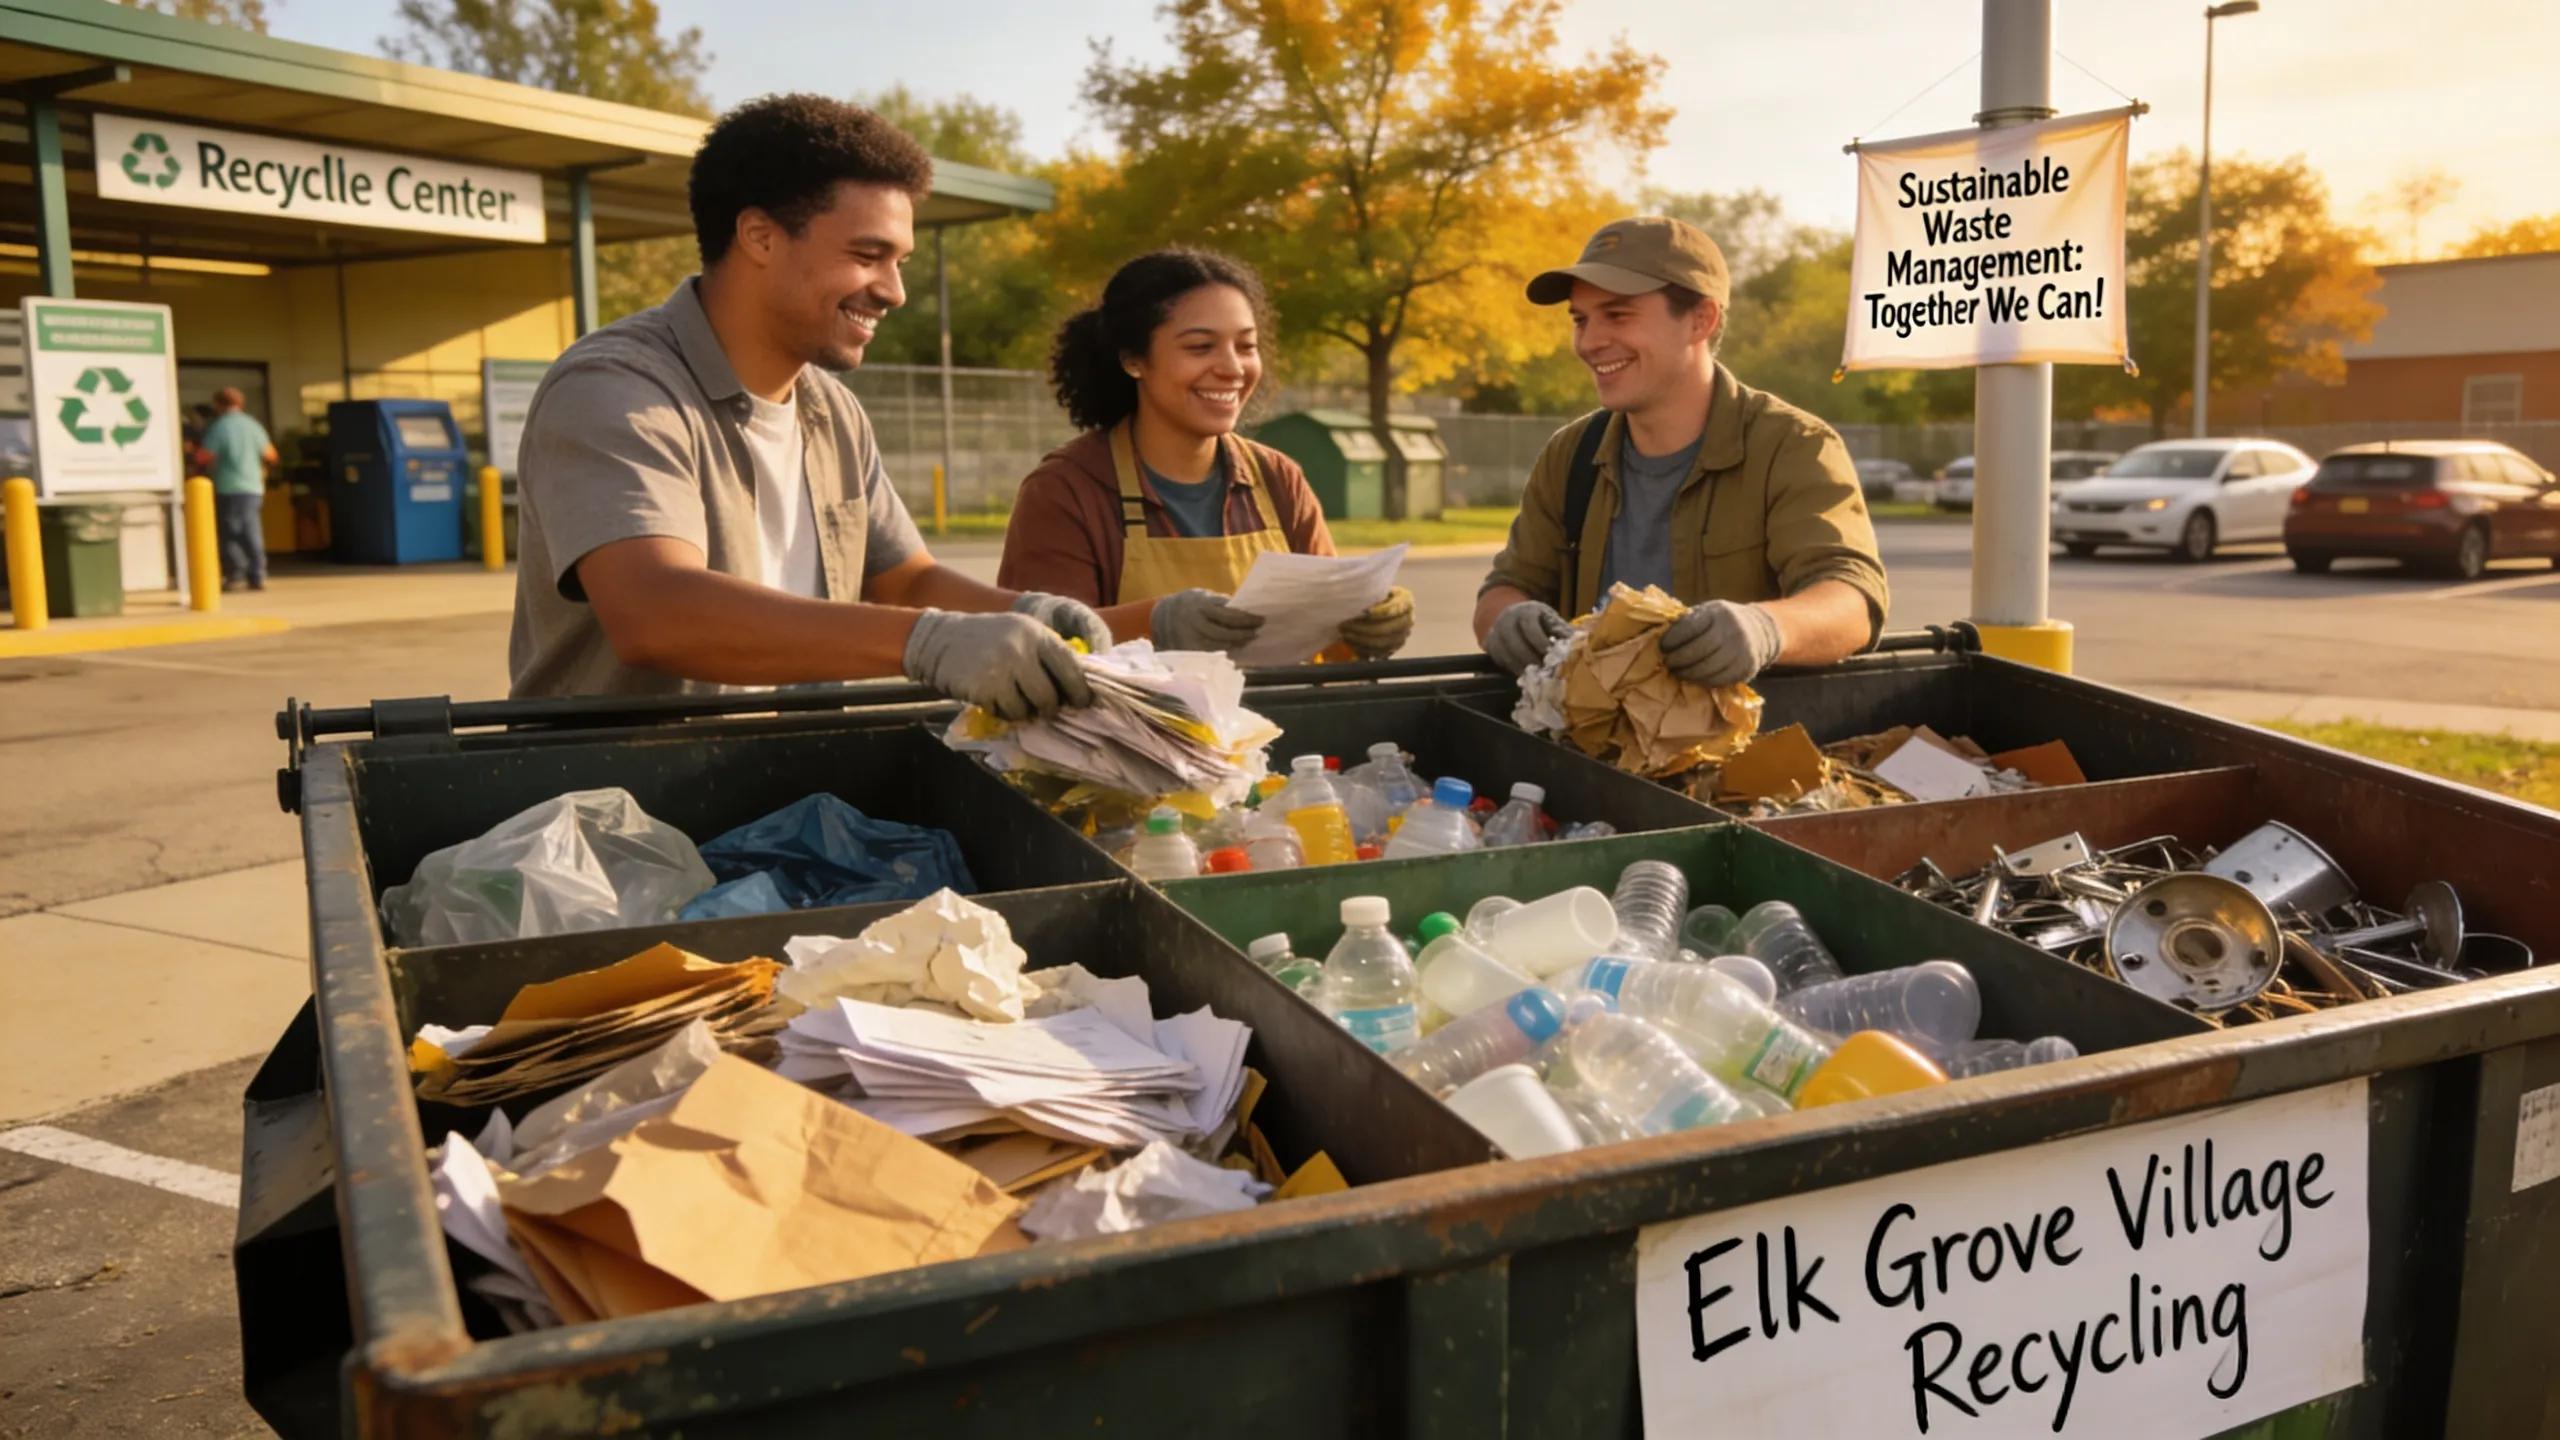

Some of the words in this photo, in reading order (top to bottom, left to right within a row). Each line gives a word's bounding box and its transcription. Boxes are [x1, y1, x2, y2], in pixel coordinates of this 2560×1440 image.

[197, 141, 373, 209] Recyclle
[386, 166, 517, 223] Center
[1898, 156, 2070, 208] Sustainable
[1922, 208, 2012, 246] Waste
[1887, 239, 2084, 291] Management:
[1864, 291, 1981, 338] Together
[1986, 286, 2030, 324] We
[2037, 277, 2105, 320] Can!
[1684, 1225, 1841, 1363] Elk
[1864, 1202, 2083, 1312] Grove
[2105, 1137, 2336, 1263] Village
[1902, 1273, 2249, 1434] Recycling
